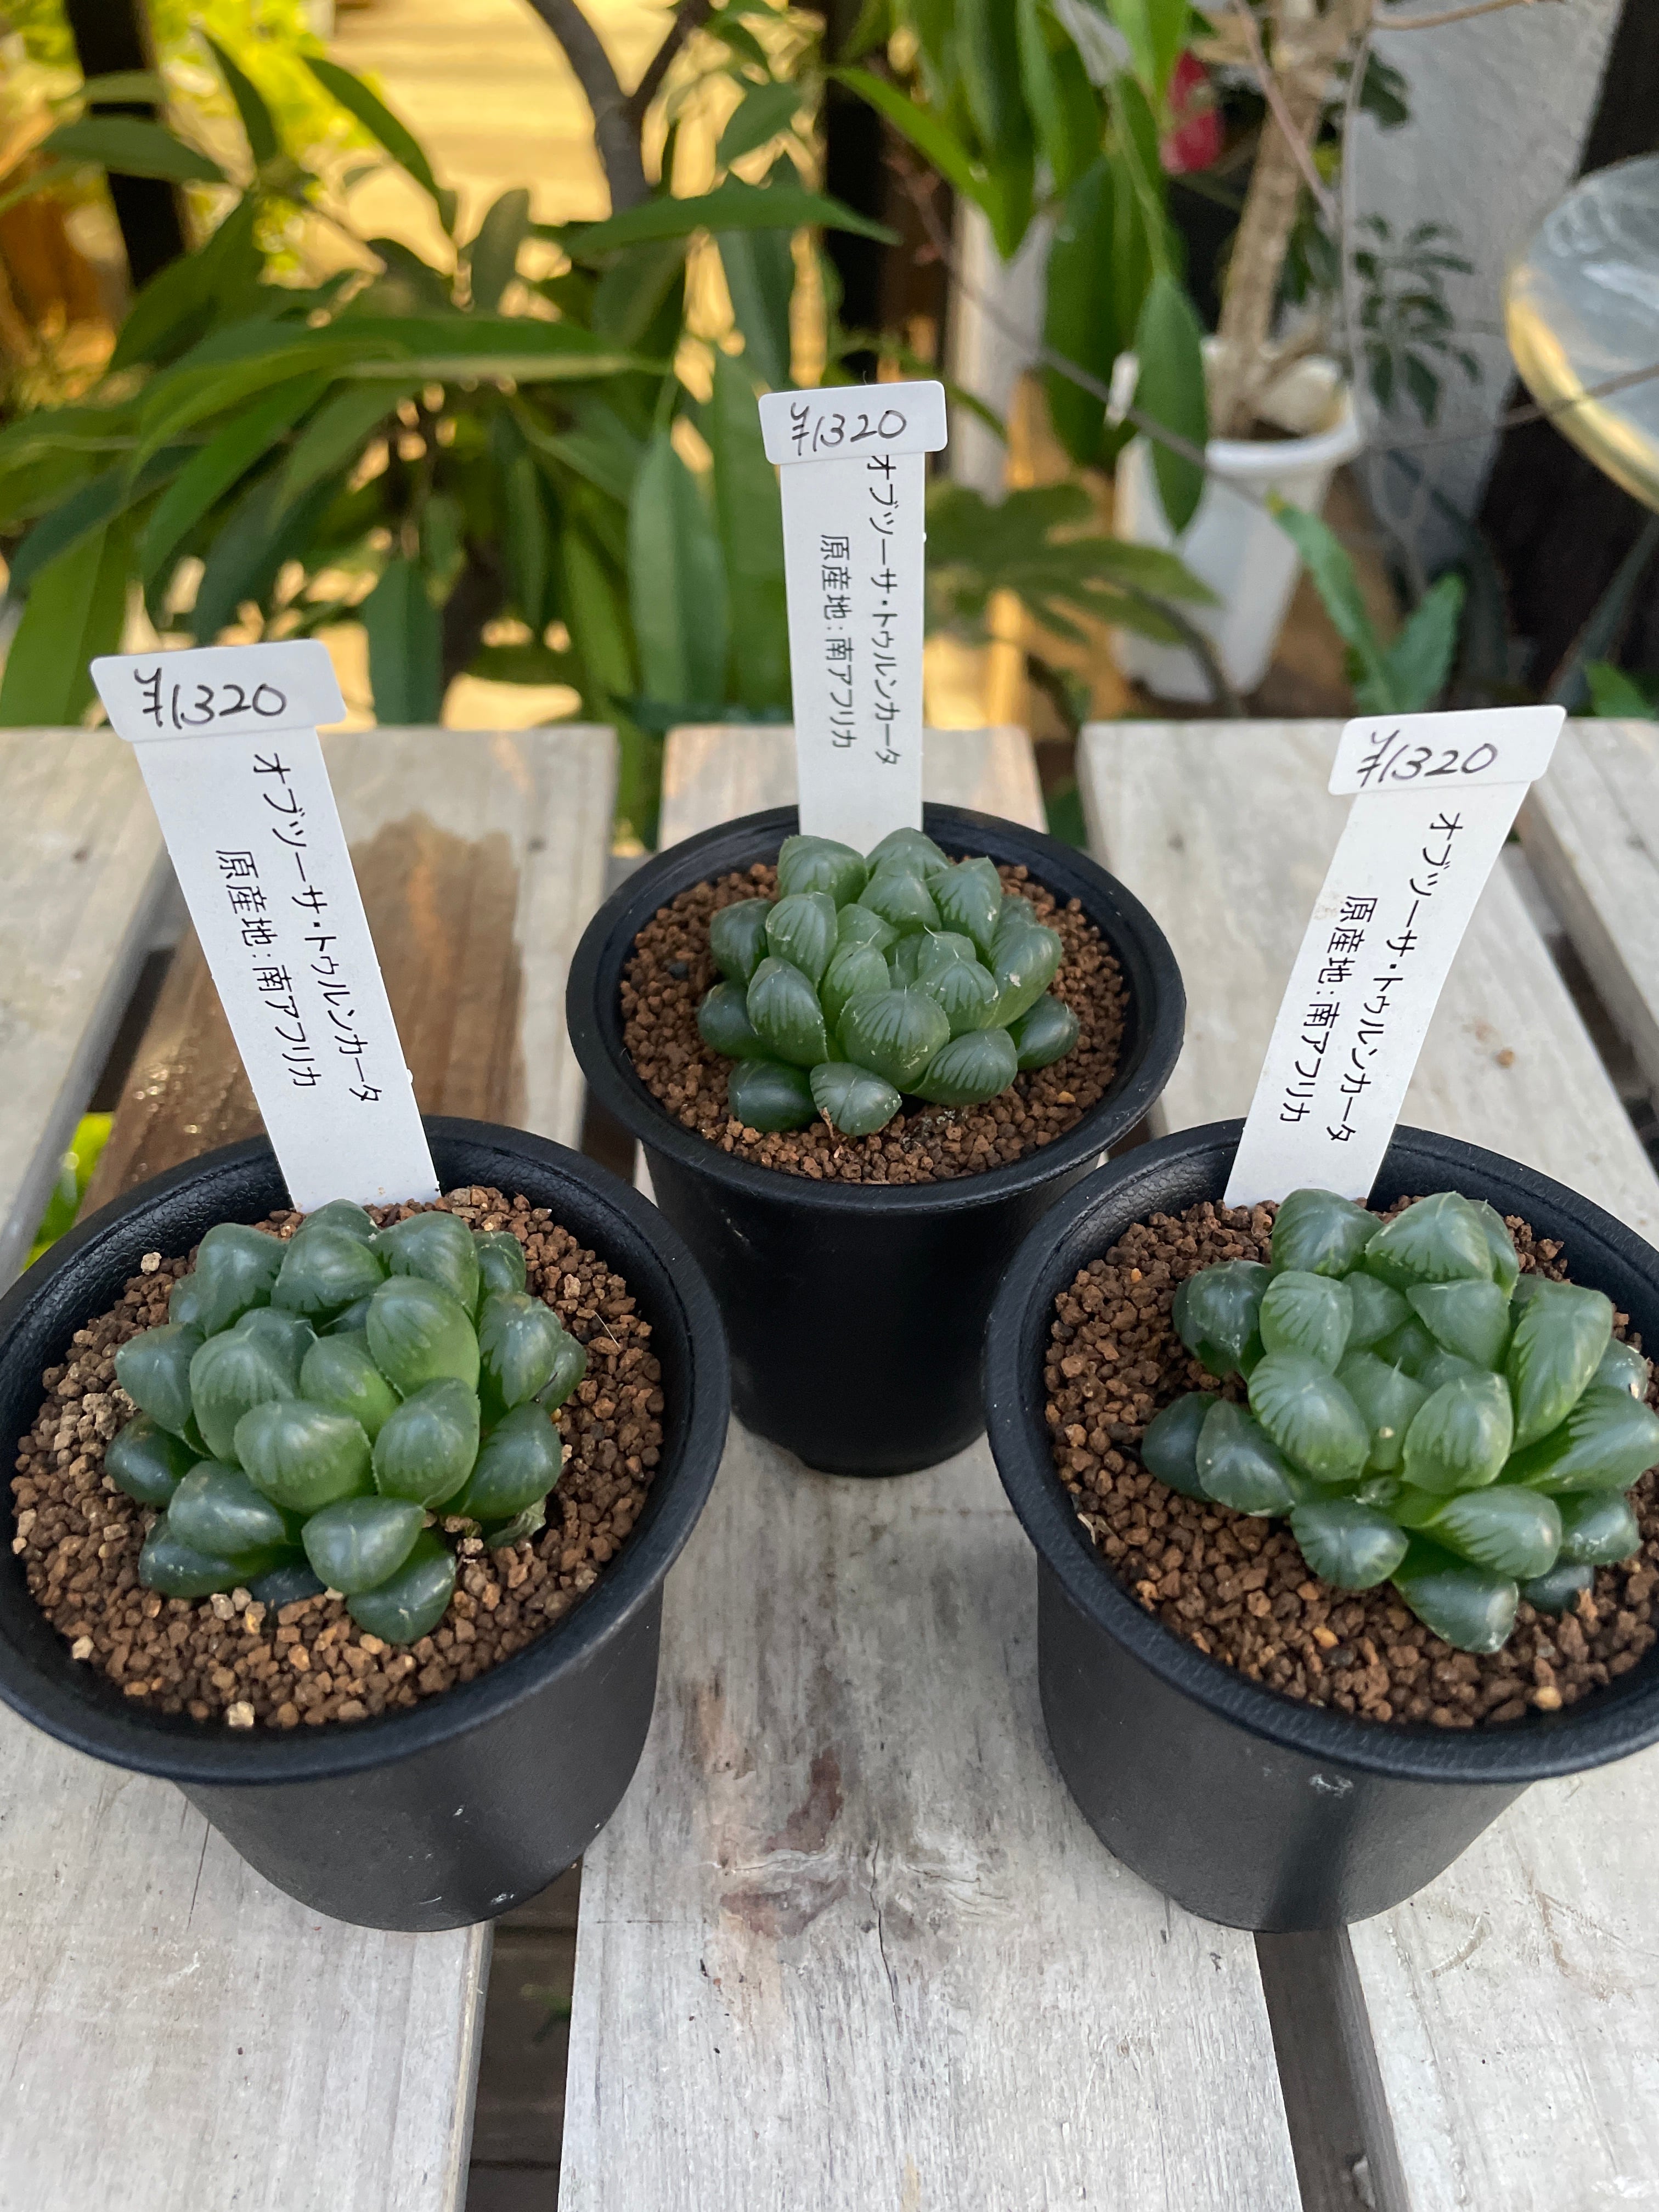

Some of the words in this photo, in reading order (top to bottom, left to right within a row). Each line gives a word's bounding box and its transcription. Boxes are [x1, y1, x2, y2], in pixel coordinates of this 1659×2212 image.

[819, 534, 857, 749] 原産地:南アフリカ
[216, 850, 321, 1087] 原産地:南アフリカ
[1279, 896, 1378, 1123] 原産地:南アフリカ
